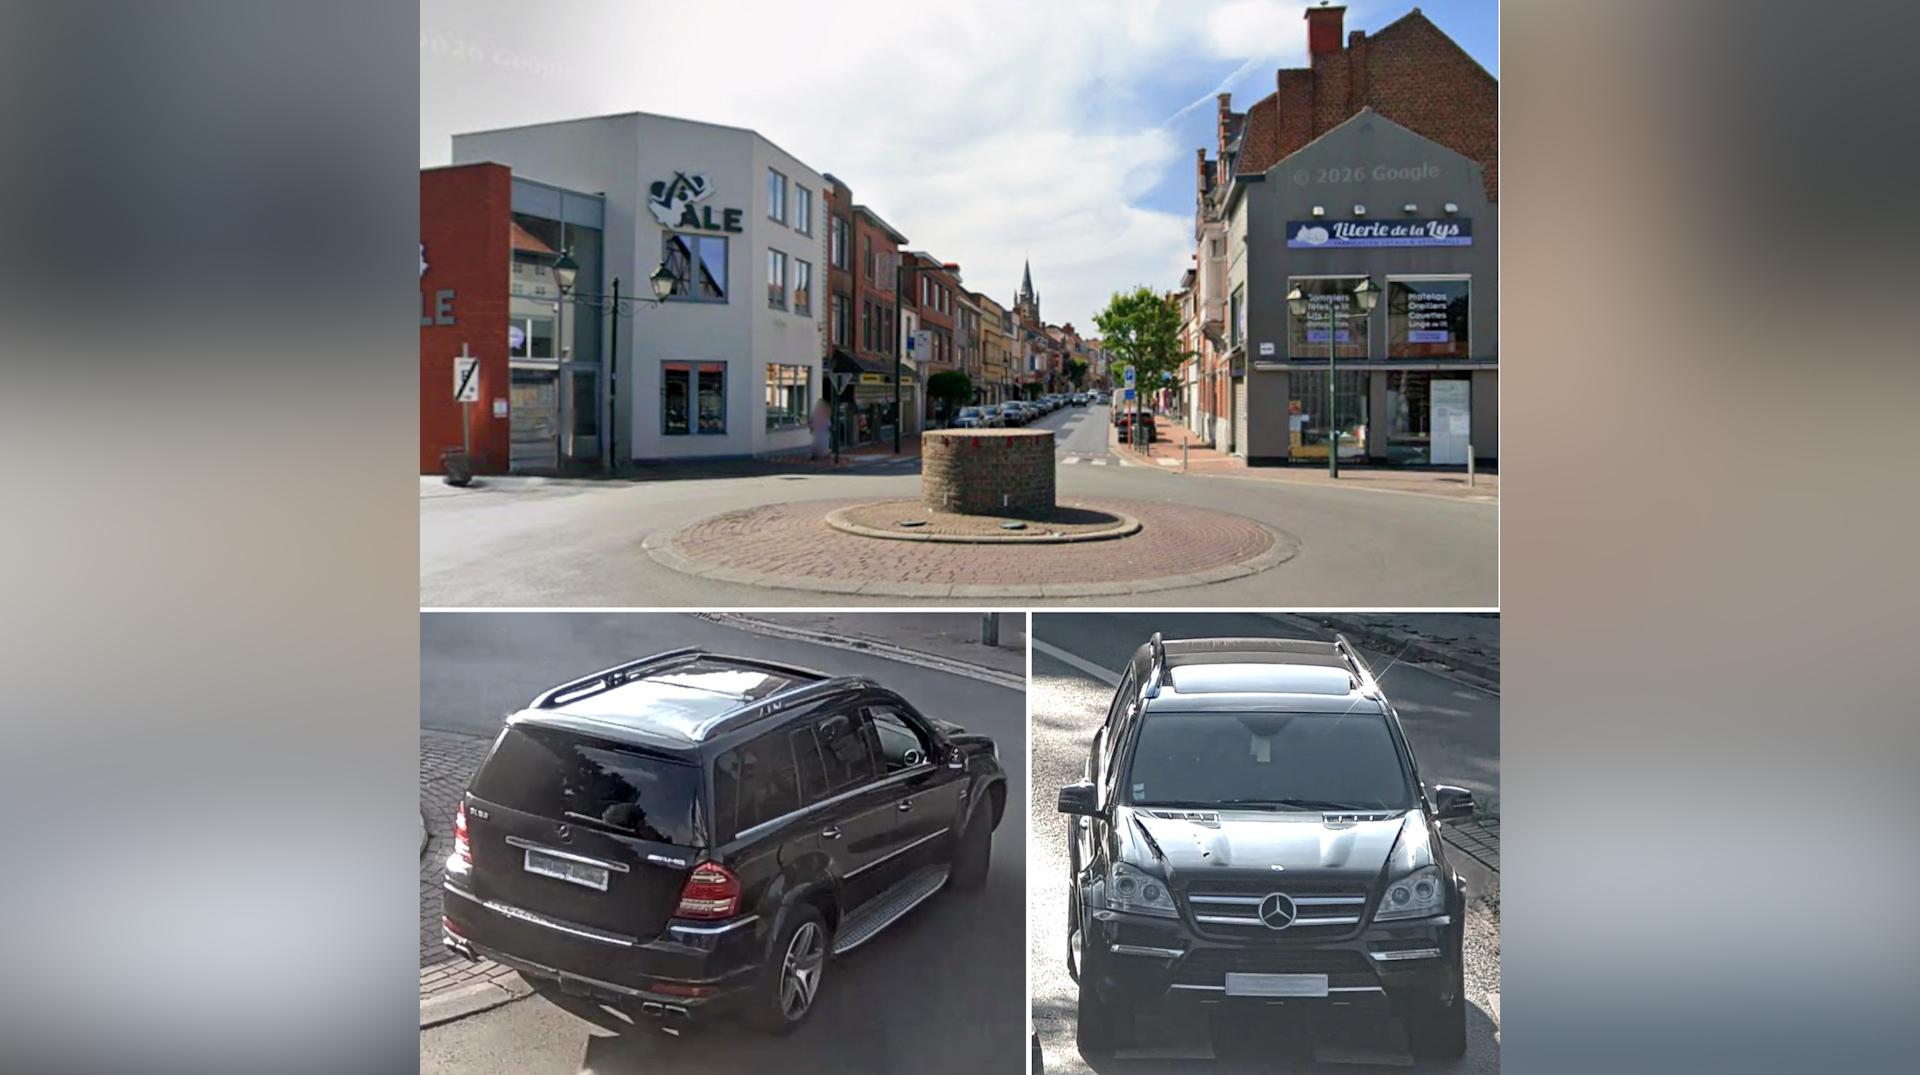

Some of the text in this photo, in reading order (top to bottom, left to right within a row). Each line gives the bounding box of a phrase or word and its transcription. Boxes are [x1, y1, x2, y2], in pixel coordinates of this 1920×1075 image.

[673, 203, 743, 233] ALE
[1333, 221, 1459, 240] Literie de la Lys
[1408, 292, 1447, 301] Matelas
[1408, 302, 1447, 311] Oreillers
[1408, 320, 1430, 328] Linge
